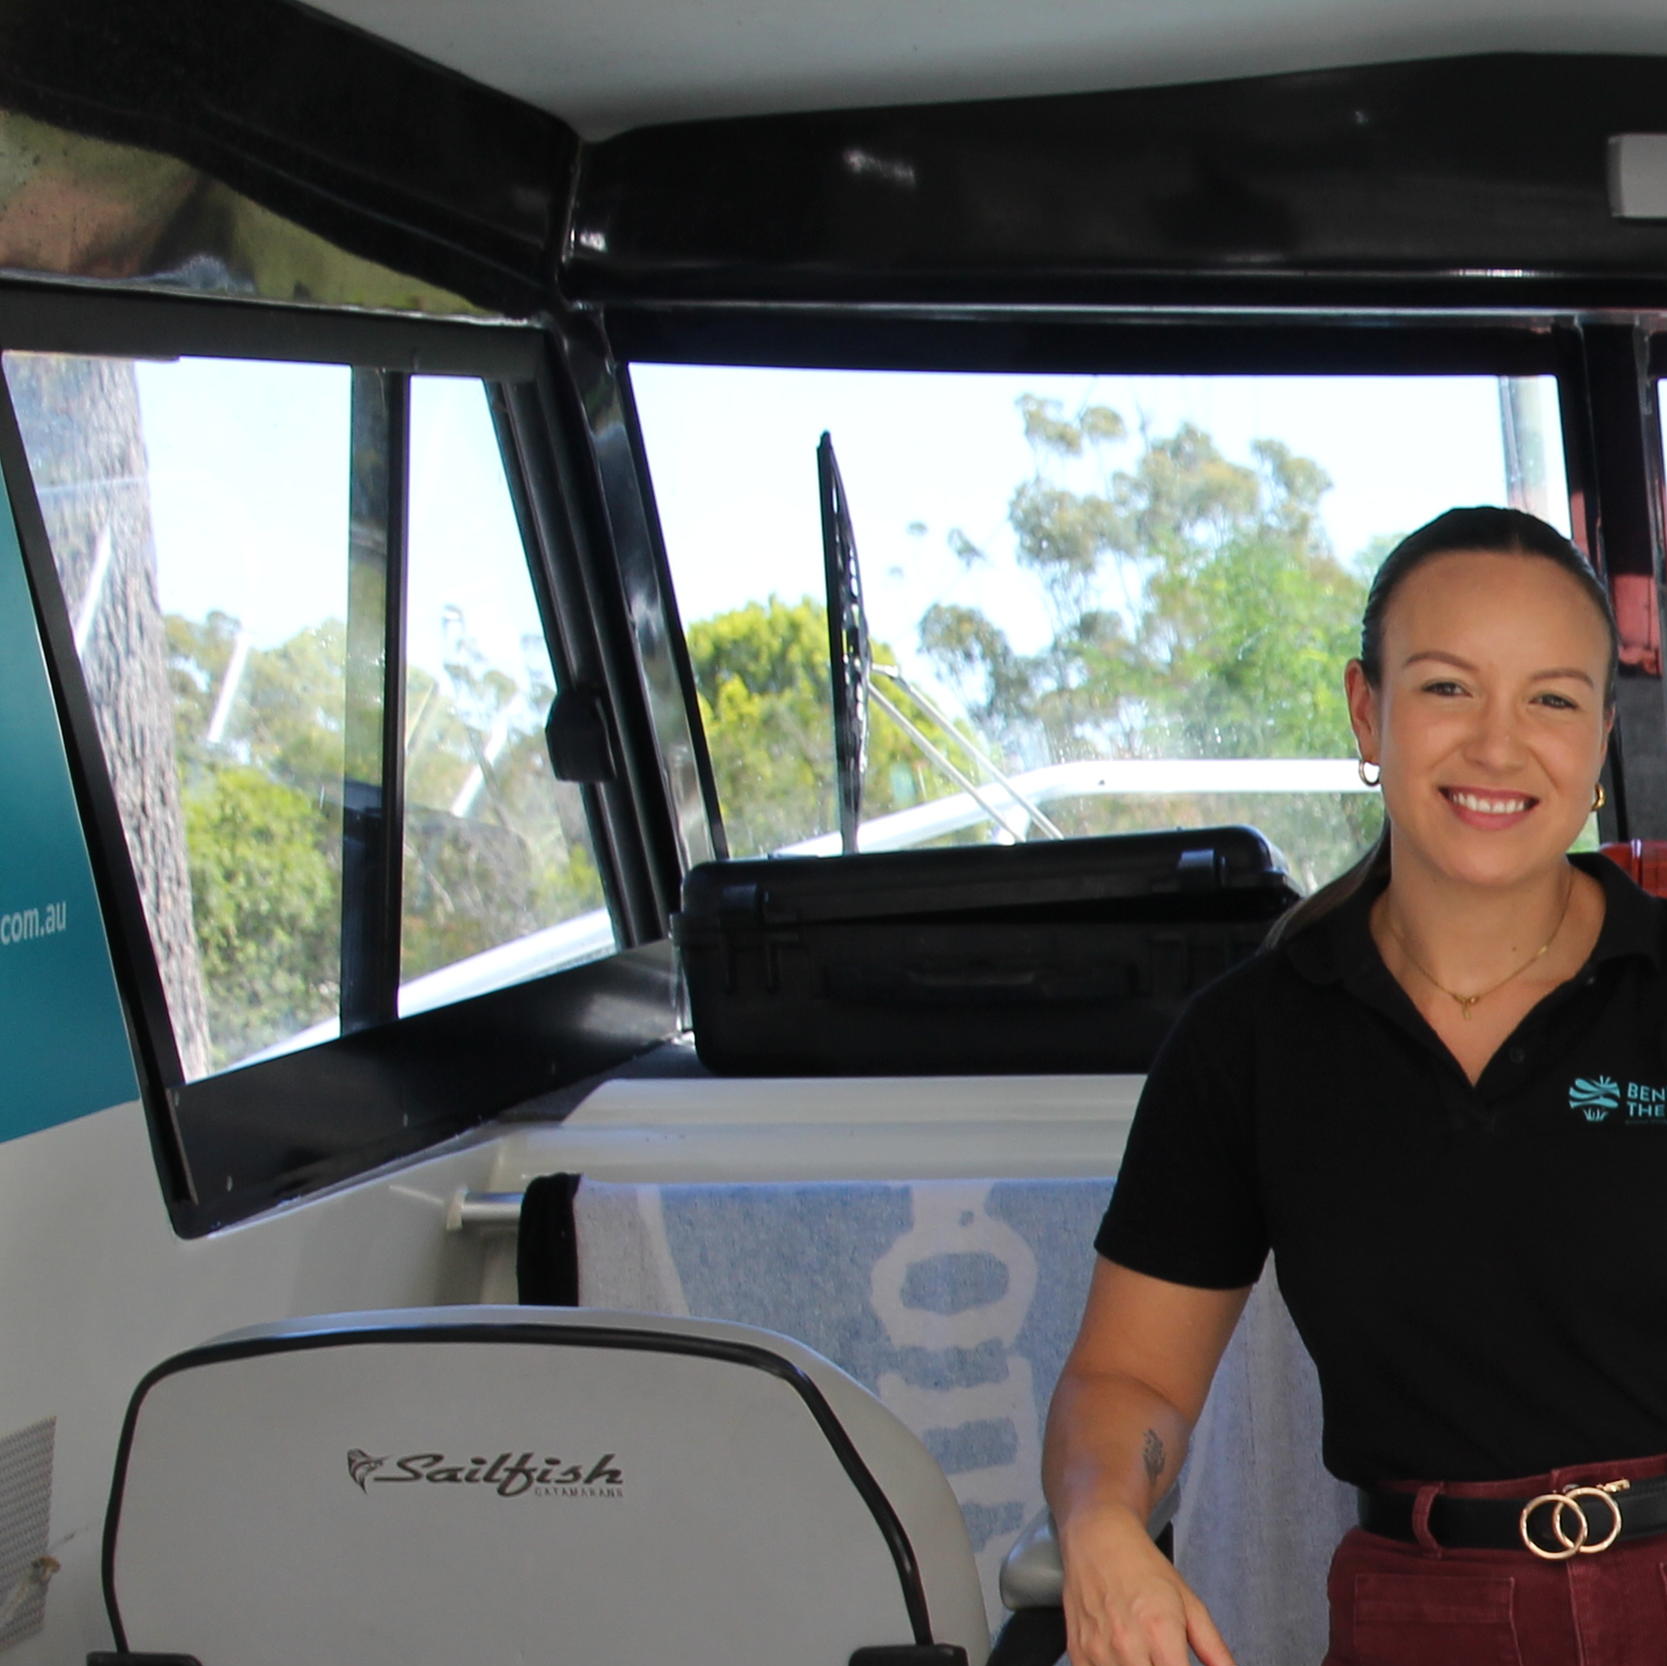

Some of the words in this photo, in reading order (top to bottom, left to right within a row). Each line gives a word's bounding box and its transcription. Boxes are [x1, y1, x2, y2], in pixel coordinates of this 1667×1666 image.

[0, 900, 67, 946] com.au
[1625, 1100, 1666, 1118] THE
[372, 1451, 625, 1498] Sailfish
